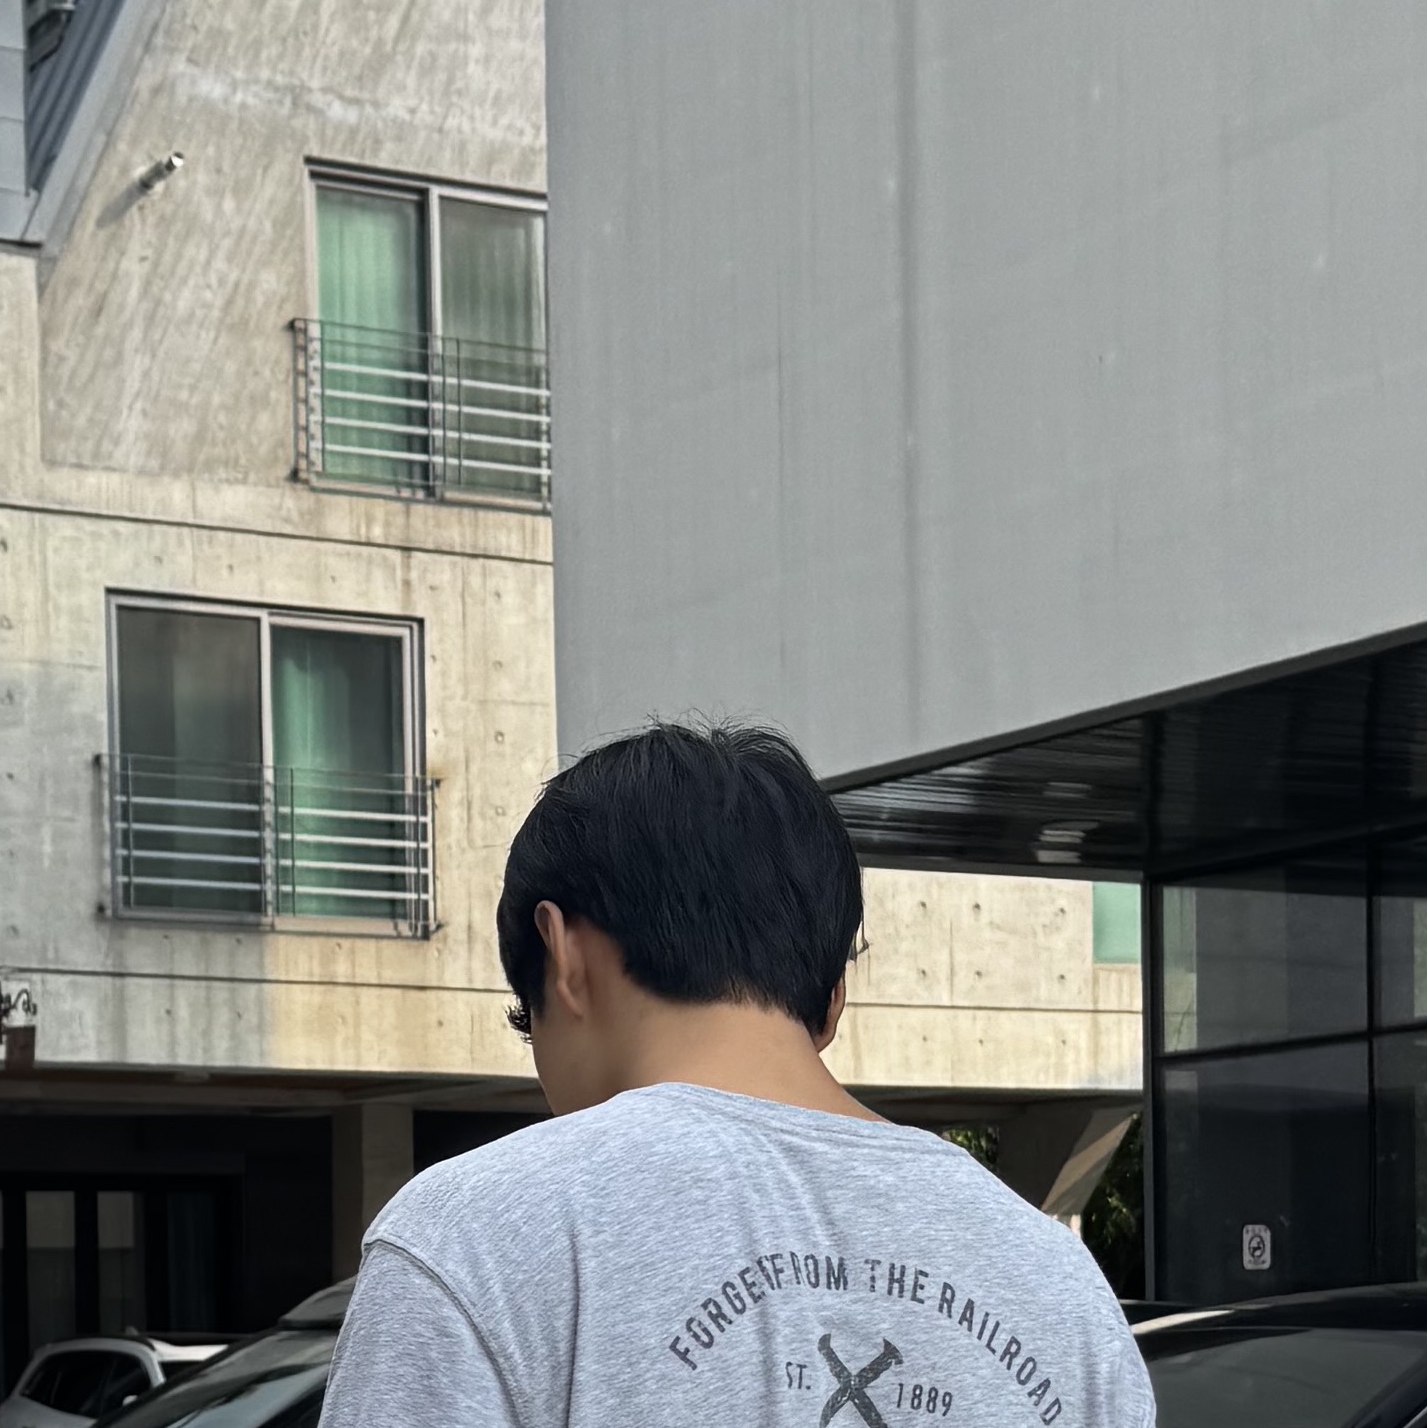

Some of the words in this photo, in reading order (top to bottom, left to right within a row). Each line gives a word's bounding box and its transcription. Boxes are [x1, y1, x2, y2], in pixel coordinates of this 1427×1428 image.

[864, 1258, 929, 1305] THE
[938, 1282, 1062, 1426] RAILROAD
[897, 1382, 954, 1417] 1889
